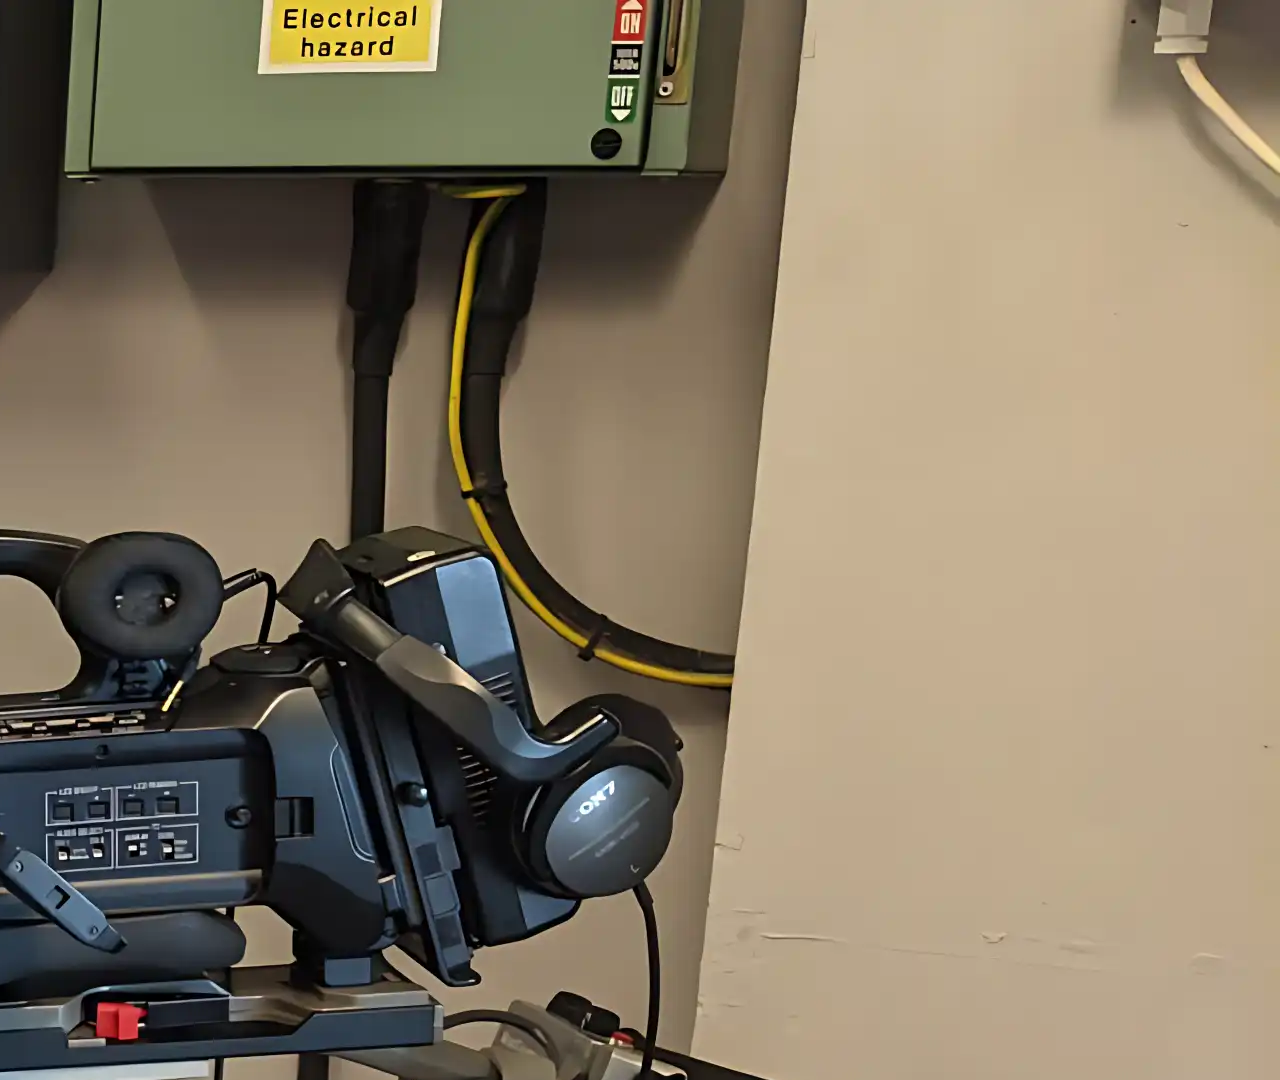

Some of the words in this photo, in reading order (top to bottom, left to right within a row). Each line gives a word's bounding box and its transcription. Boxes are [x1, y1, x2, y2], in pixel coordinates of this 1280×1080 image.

[283, 6, 417, 29] Electrical
[620, 12, 641, 34] ON
[301, 36, 394, 57] hazard
